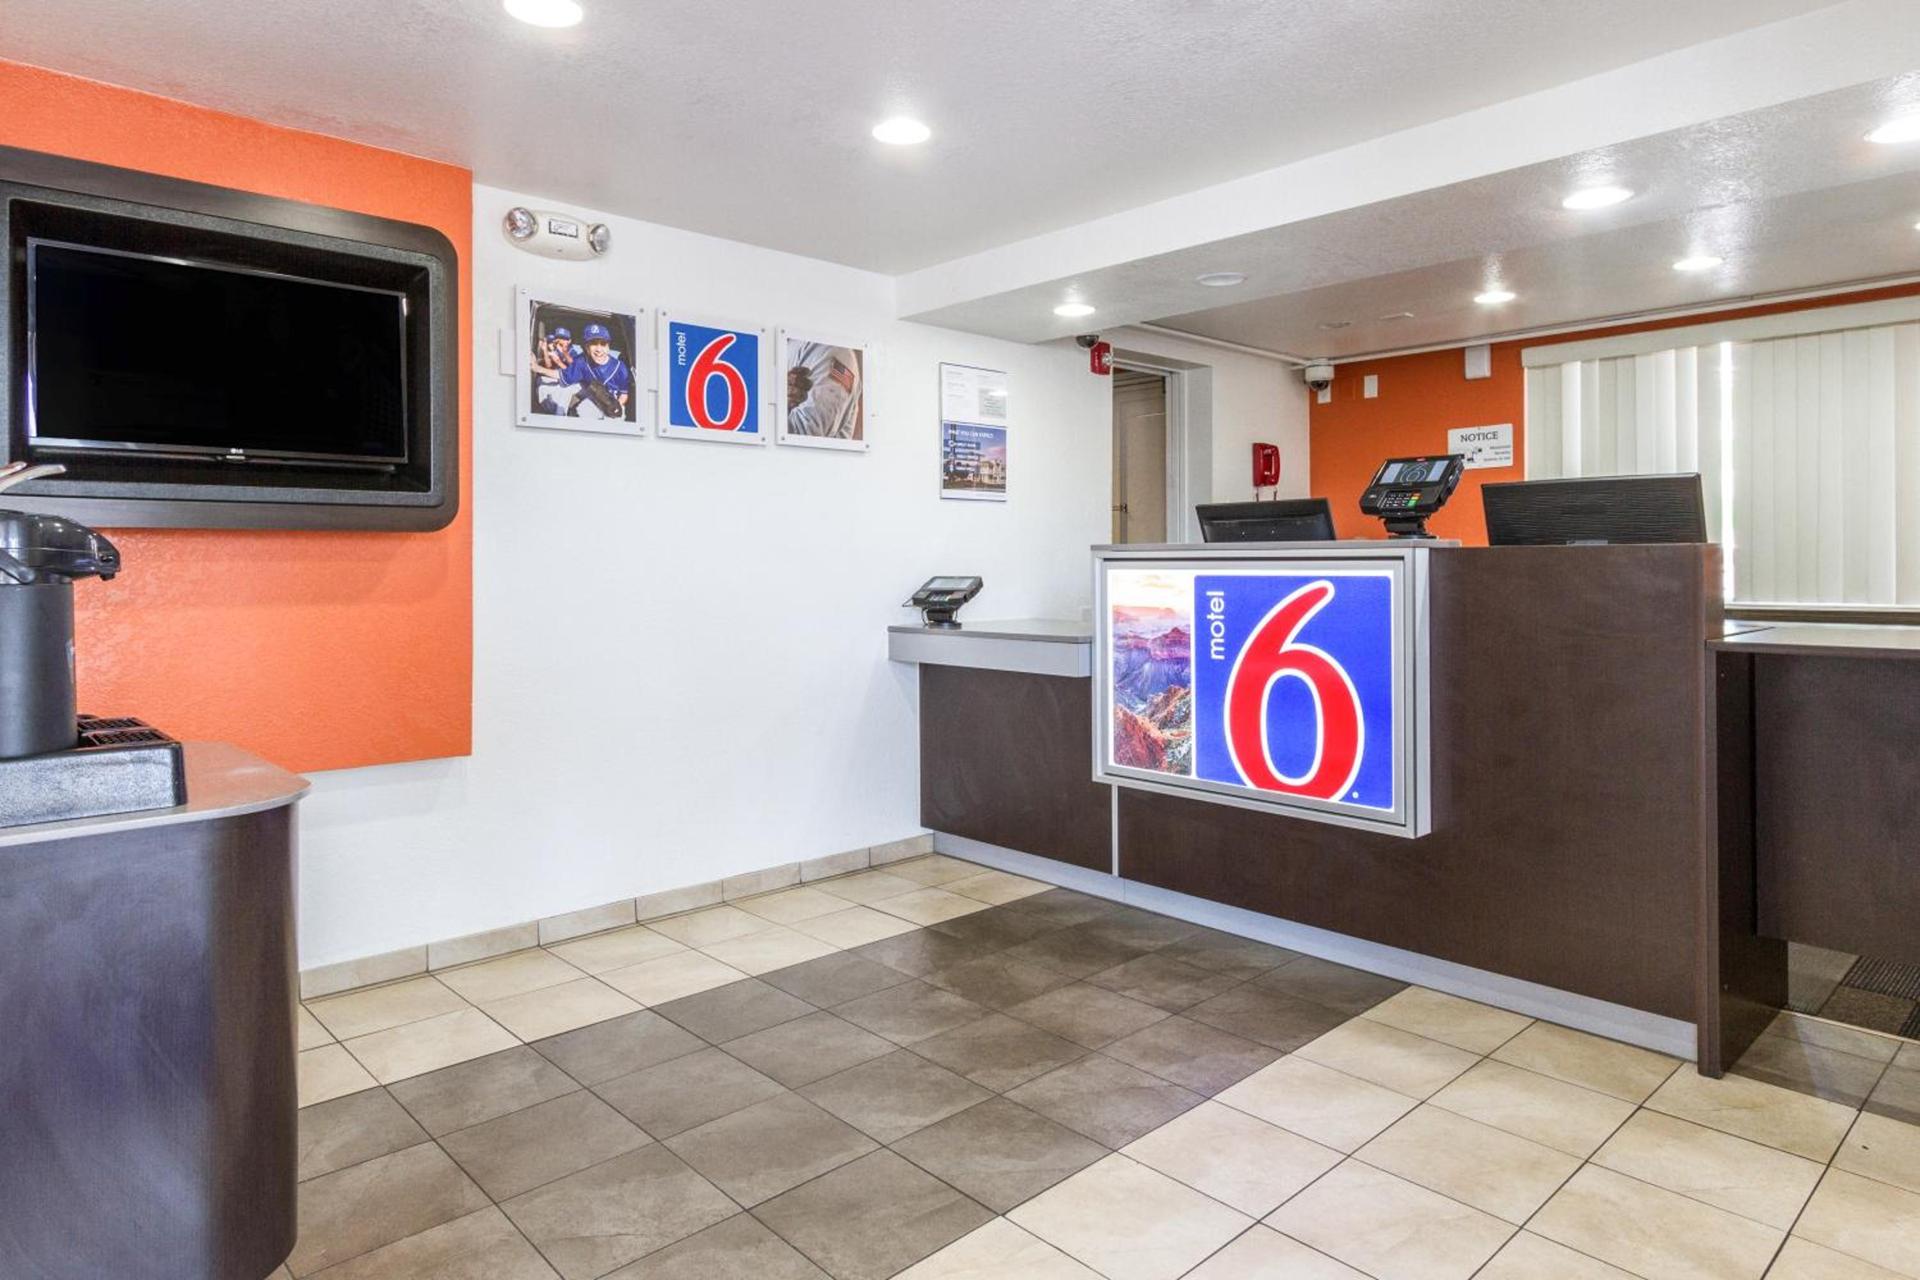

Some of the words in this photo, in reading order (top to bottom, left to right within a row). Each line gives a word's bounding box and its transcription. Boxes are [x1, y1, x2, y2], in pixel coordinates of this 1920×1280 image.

[676, 331, 687, 366] motel
[685, 333, 749, 431] 6
[1460, 430, 1499, 443] NOTICE
[1206, 590, 1225, 660] motel
[1223, 580, 1365, 801] 6
